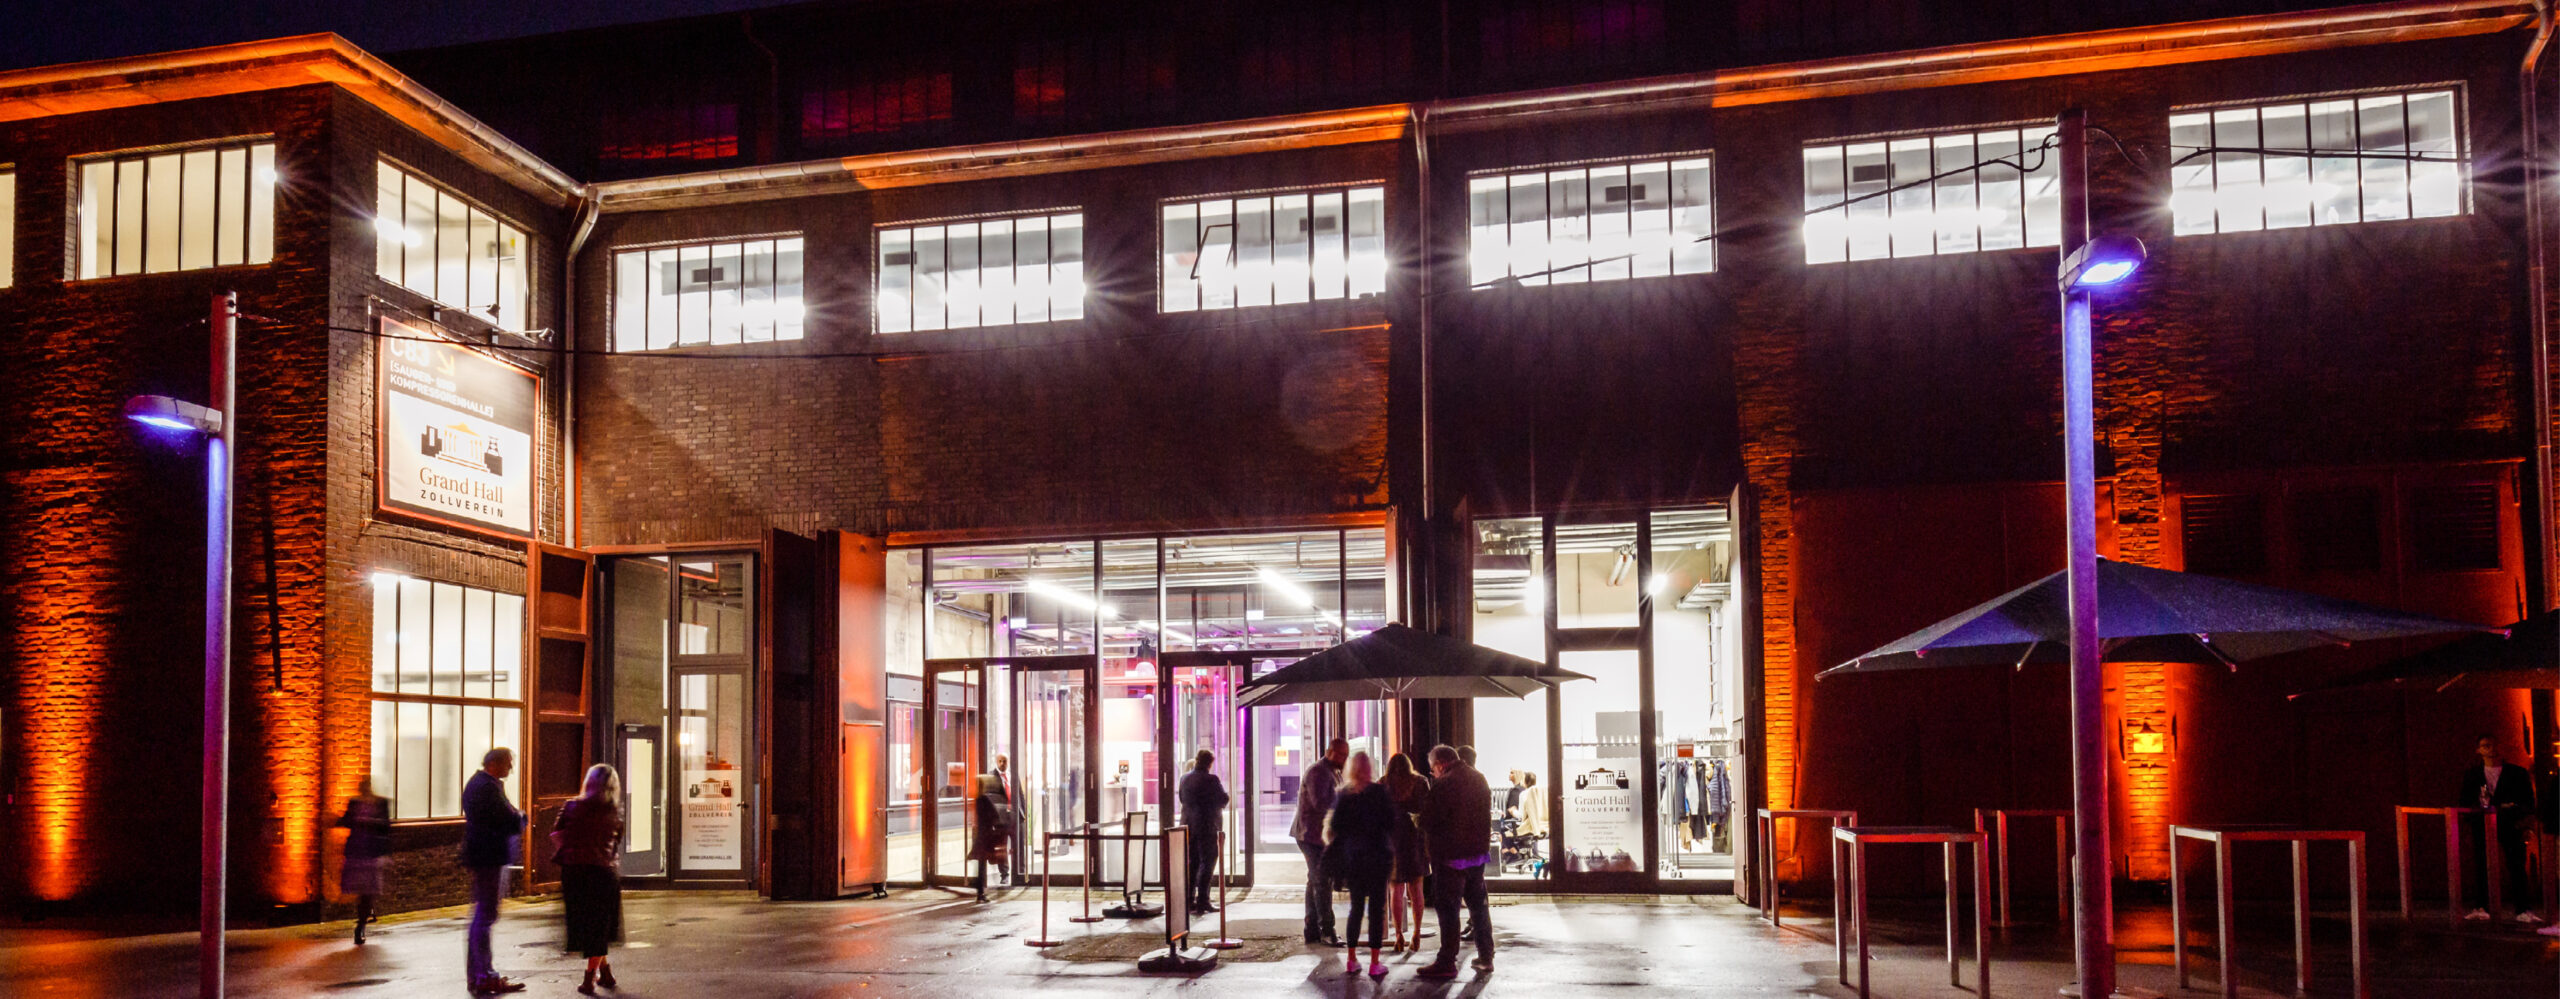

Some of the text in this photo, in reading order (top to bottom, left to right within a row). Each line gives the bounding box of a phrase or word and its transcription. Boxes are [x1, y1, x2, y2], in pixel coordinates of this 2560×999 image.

[420, 466, 503, 504] Grand Hall
[420, 489, 503, 518] ZOLLVEREIN
[689, 802, 731, 811] Grand Hall
[1574, 795, 1630, 805] Grand Hall
